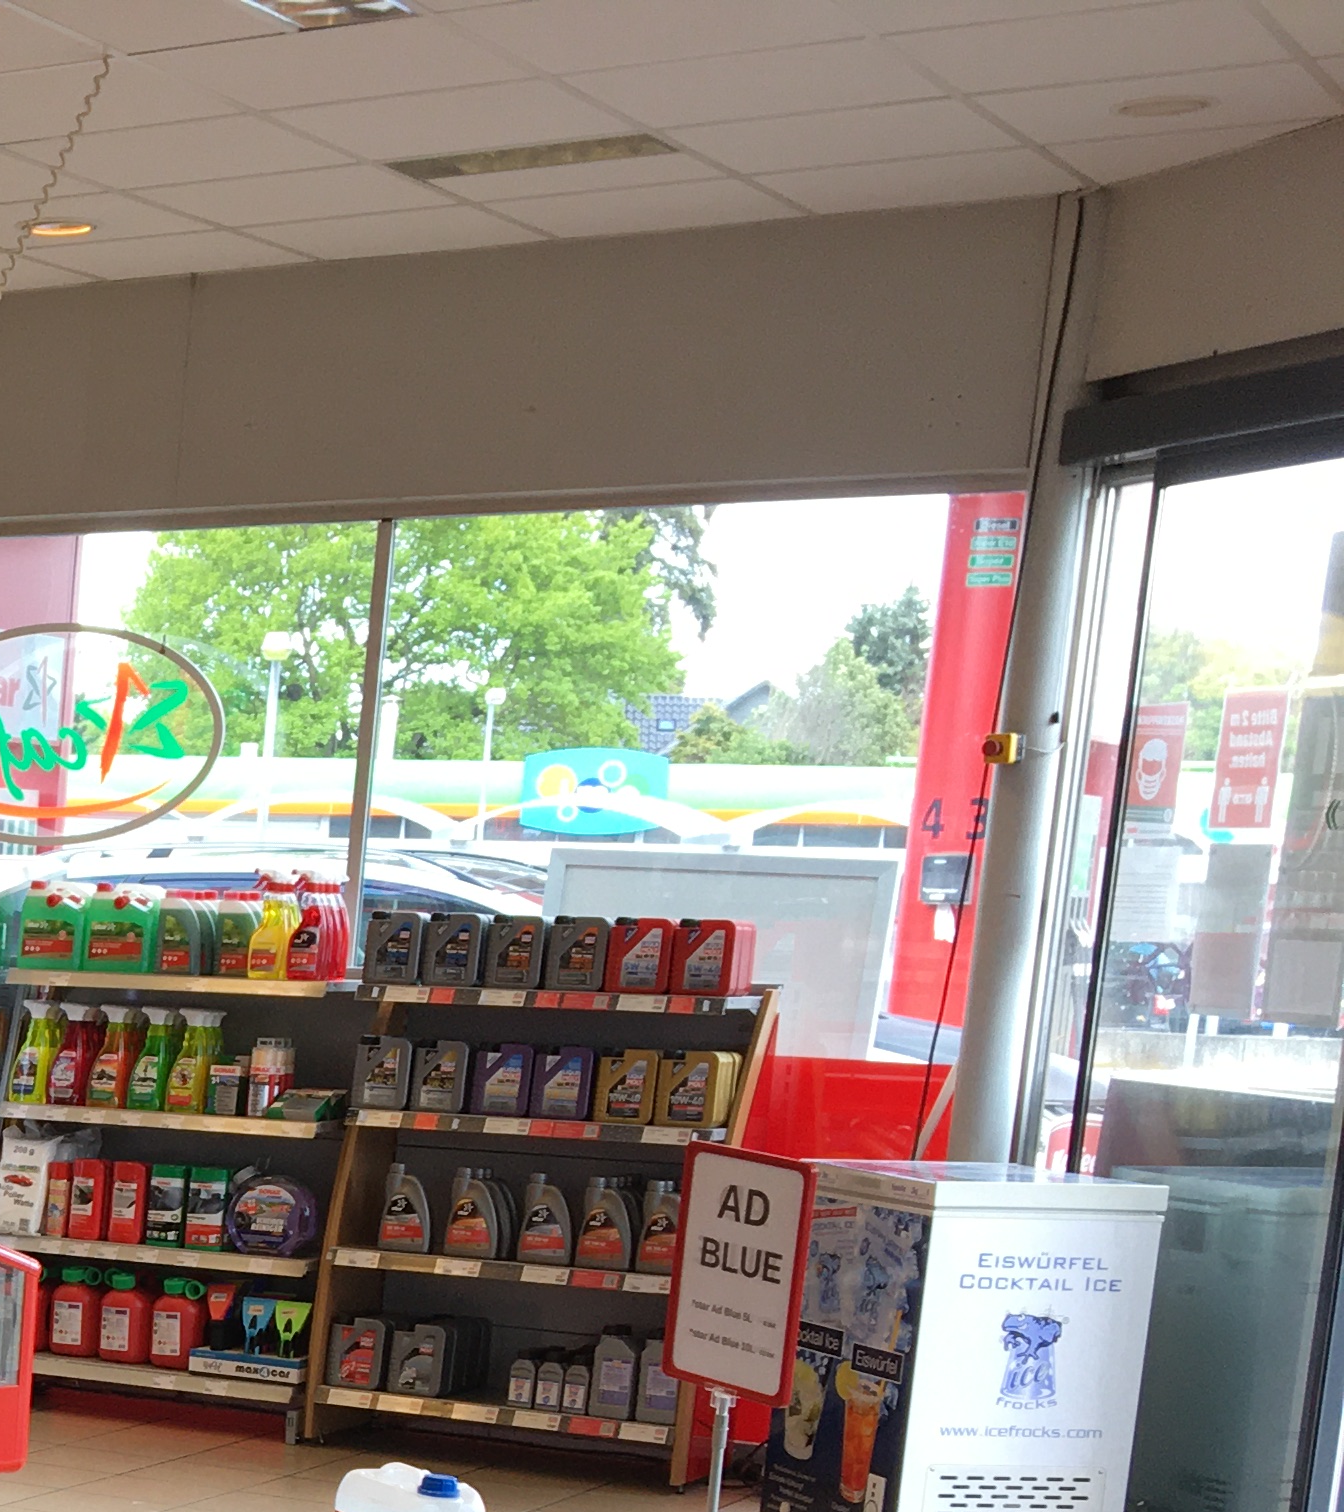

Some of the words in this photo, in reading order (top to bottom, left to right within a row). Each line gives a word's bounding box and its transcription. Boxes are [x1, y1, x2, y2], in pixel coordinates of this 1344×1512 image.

[921, 797, 945, 839] 4
[716, 1184, 771, 1227] AD
[699, 1235, 784, 1285] BLUE
[855, 1350, 898, 1375] Eiswürfel
[995, 1396, 1058, 1410] frocks
[939, 1424, 1103, 1441] www.icefrocks.com
